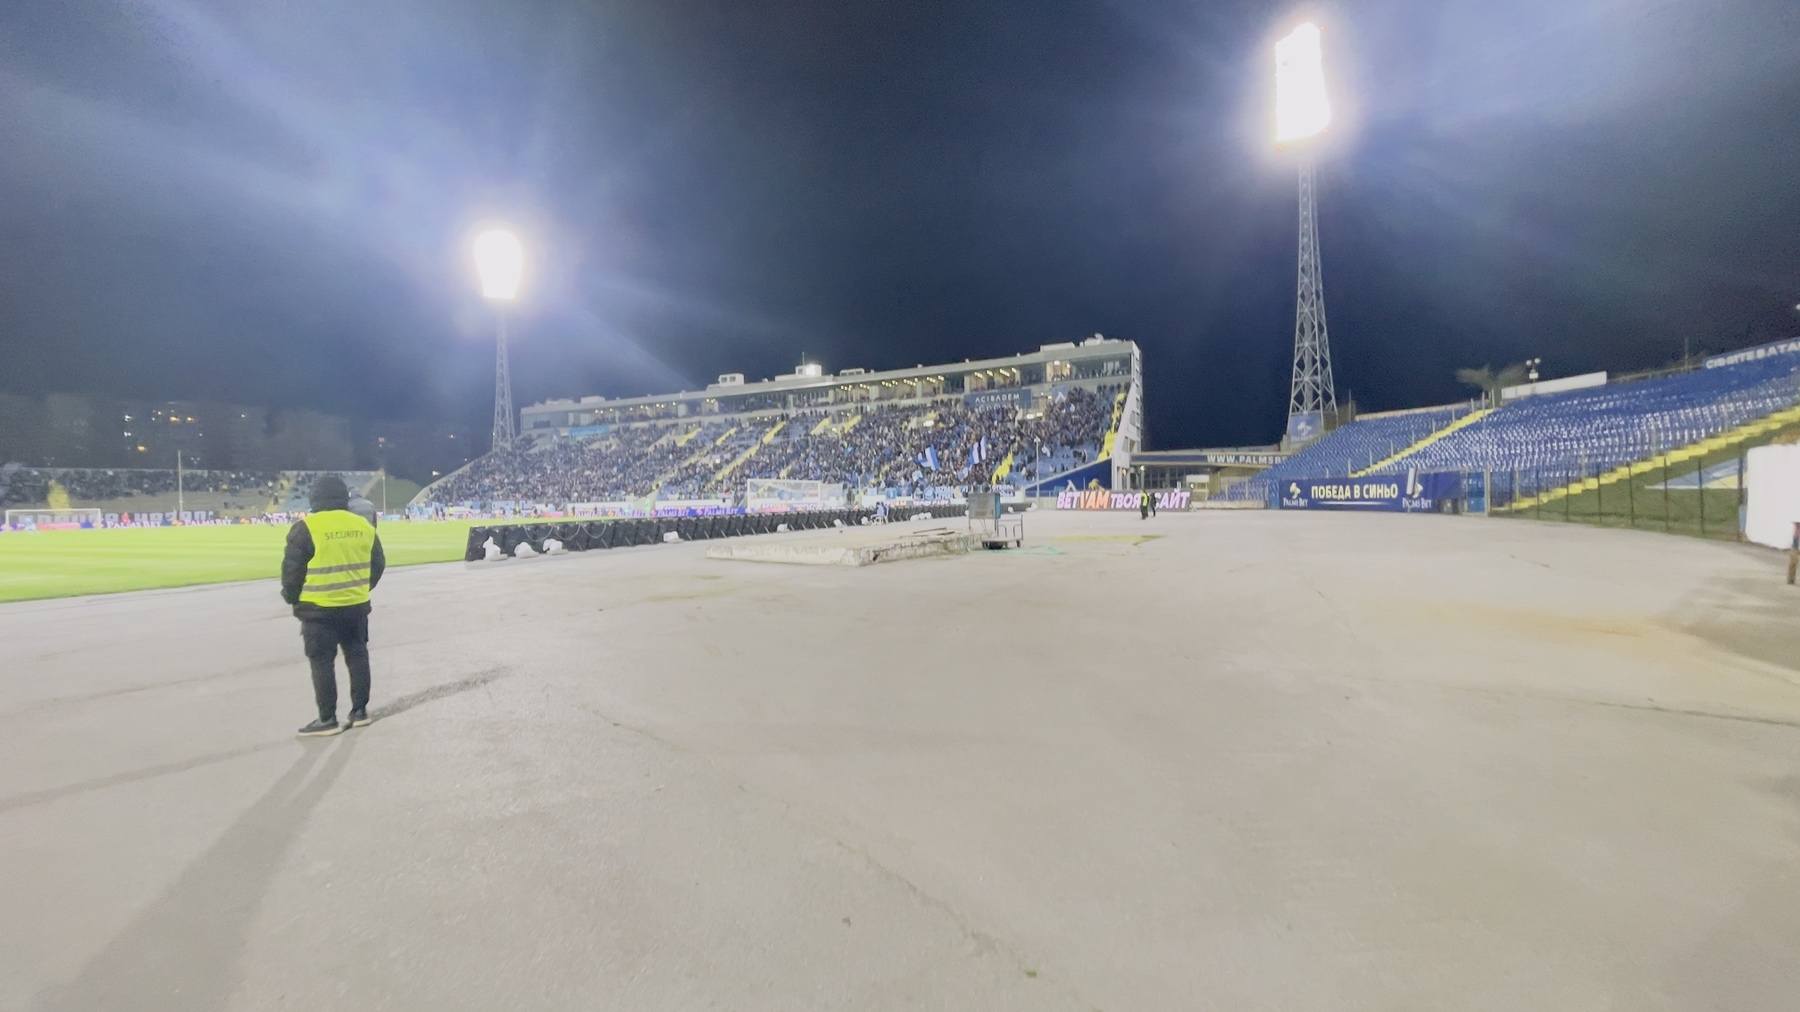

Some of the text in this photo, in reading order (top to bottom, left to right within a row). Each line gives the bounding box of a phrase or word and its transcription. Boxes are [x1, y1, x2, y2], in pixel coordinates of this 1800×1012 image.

[975, 393, 1020, 404] ACIBADEM
[1311, 483, 1399, 500] ПОБЕДА В СИНЬО
[324, 529, 364, 541] SECURITY
